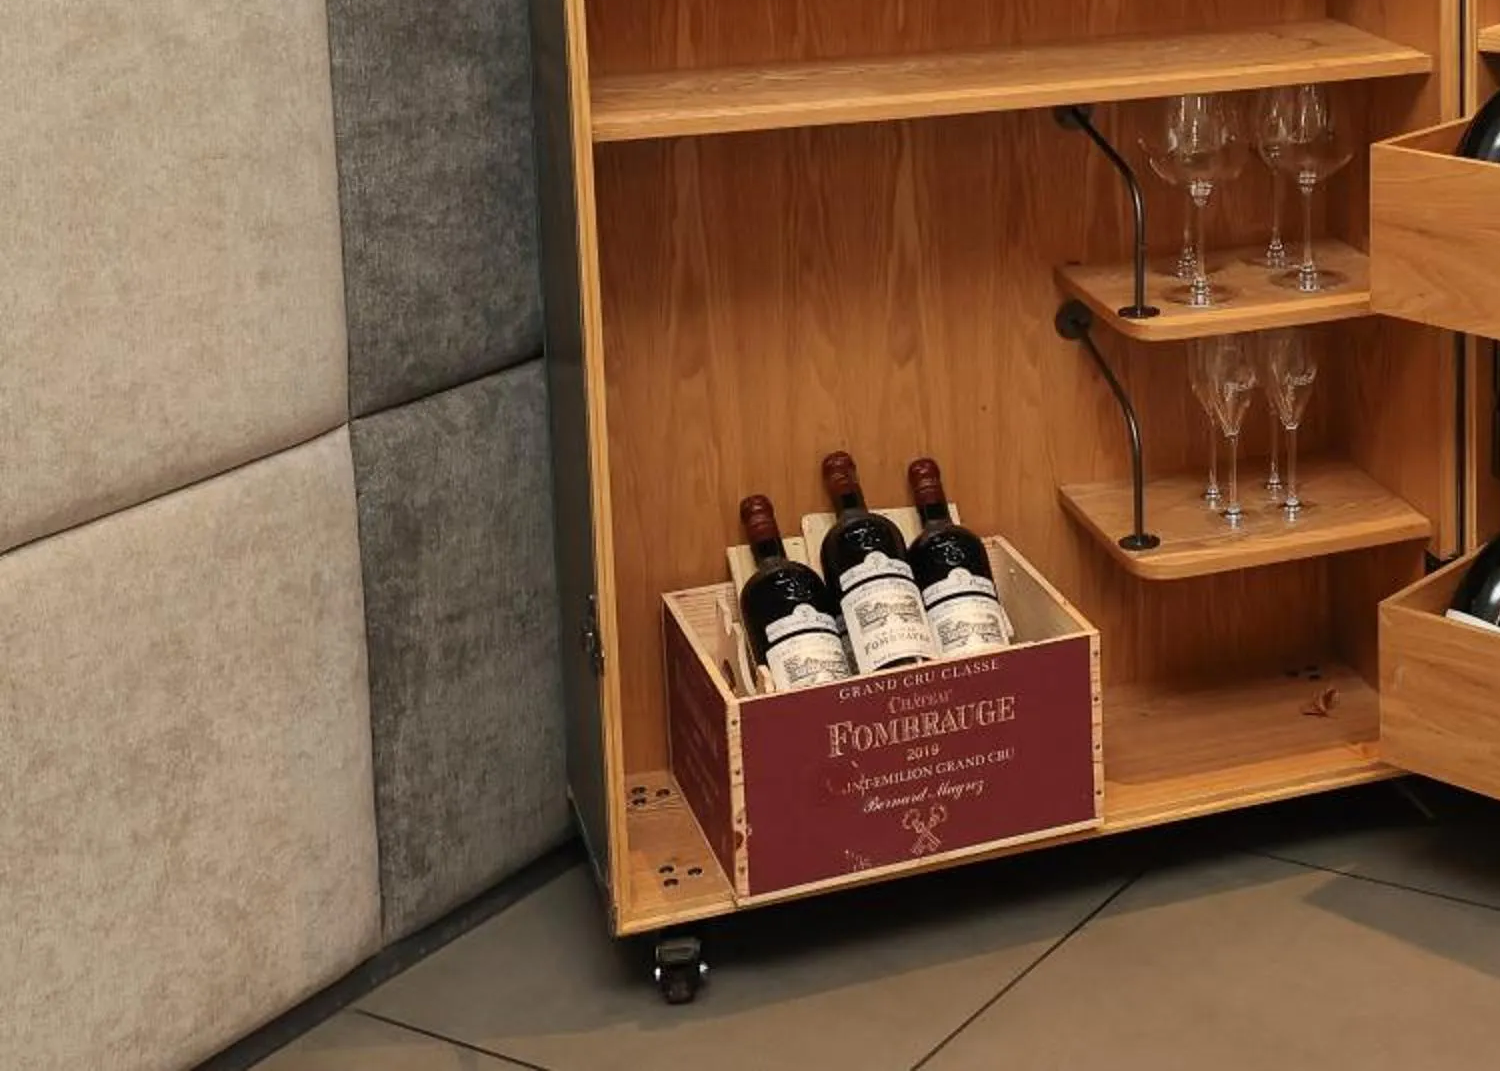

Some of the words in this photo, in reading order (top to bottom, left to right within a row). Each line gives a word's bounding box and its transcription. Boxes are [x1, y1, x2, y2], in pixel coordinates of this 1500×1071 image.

[839, 679, 898, 701] GRAND
[903, 671, 936, 689] CRU
[941, 658, 1000, 680] CLASSE
[827, 695, 1016, 759] FOMBRAUGE
[906, 743, 940, 762] 2019
[935, 752, 985, 774] GRAND
[987, 746, 1016, 765] CRU
